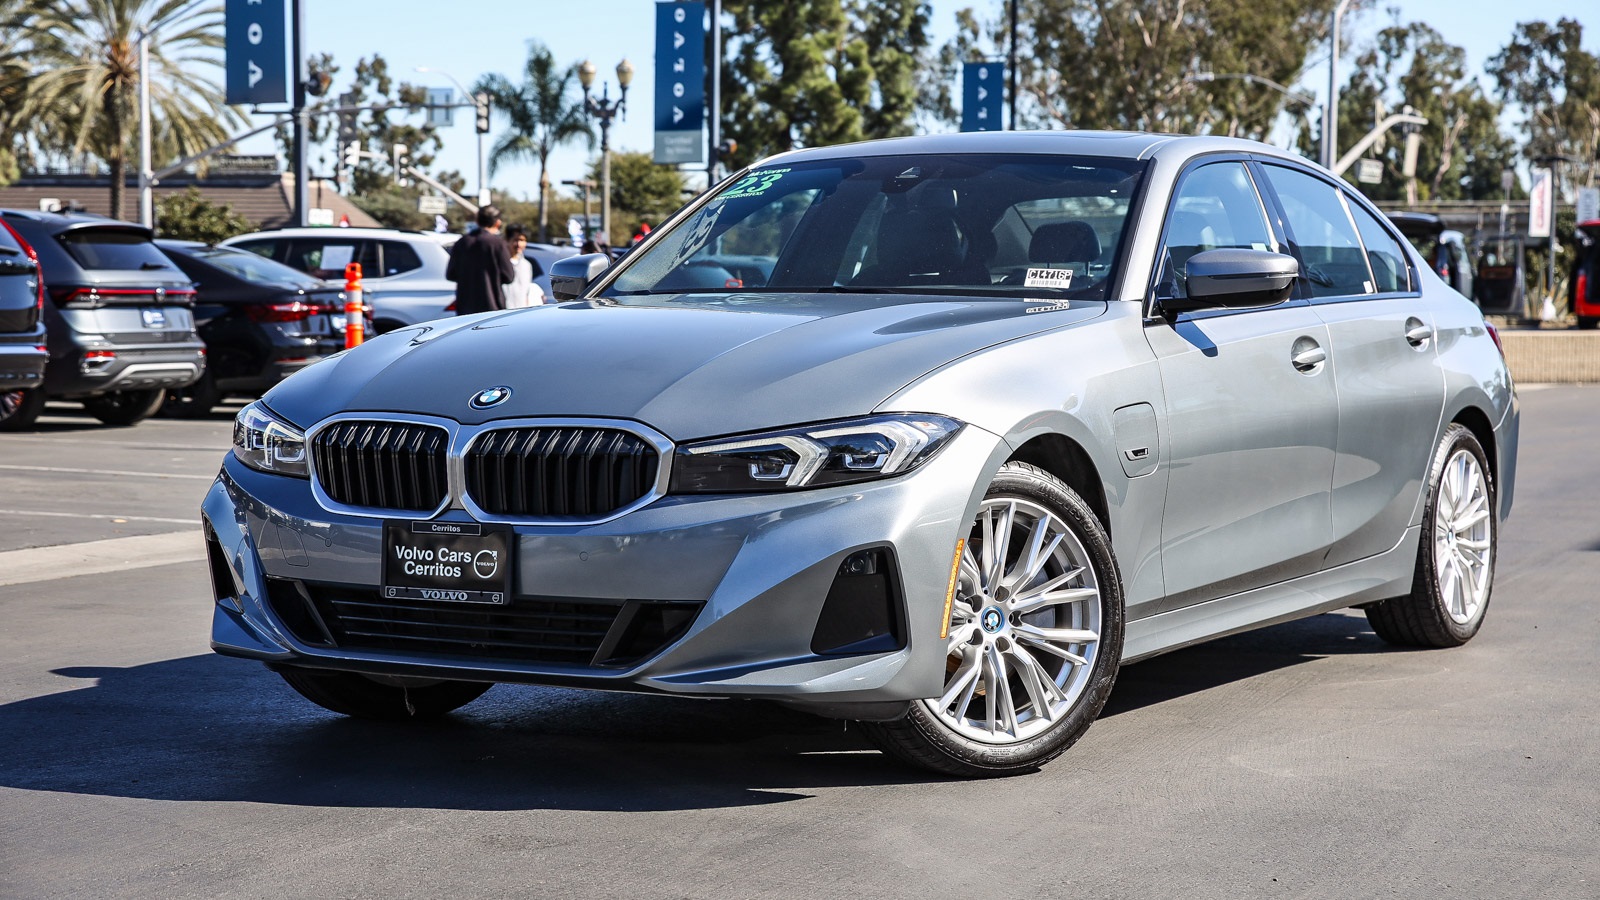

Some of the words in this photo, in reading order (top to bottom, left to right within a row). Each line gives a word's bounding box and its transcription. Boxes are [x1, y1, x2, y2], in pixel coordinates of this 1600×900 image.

[248, 0, 263, 88] VO
[672, 7, 686, 124] VOLVO
[719, 173, 783, 197] 23
[431, 524, 461, 533] Cerritos
[395, 545, 434, 561] Volvo
[438, 547, 472, 563] Cars
[404, 560, 462, 578] Cerritos
[420, 589, 468, 601] VOLVO
